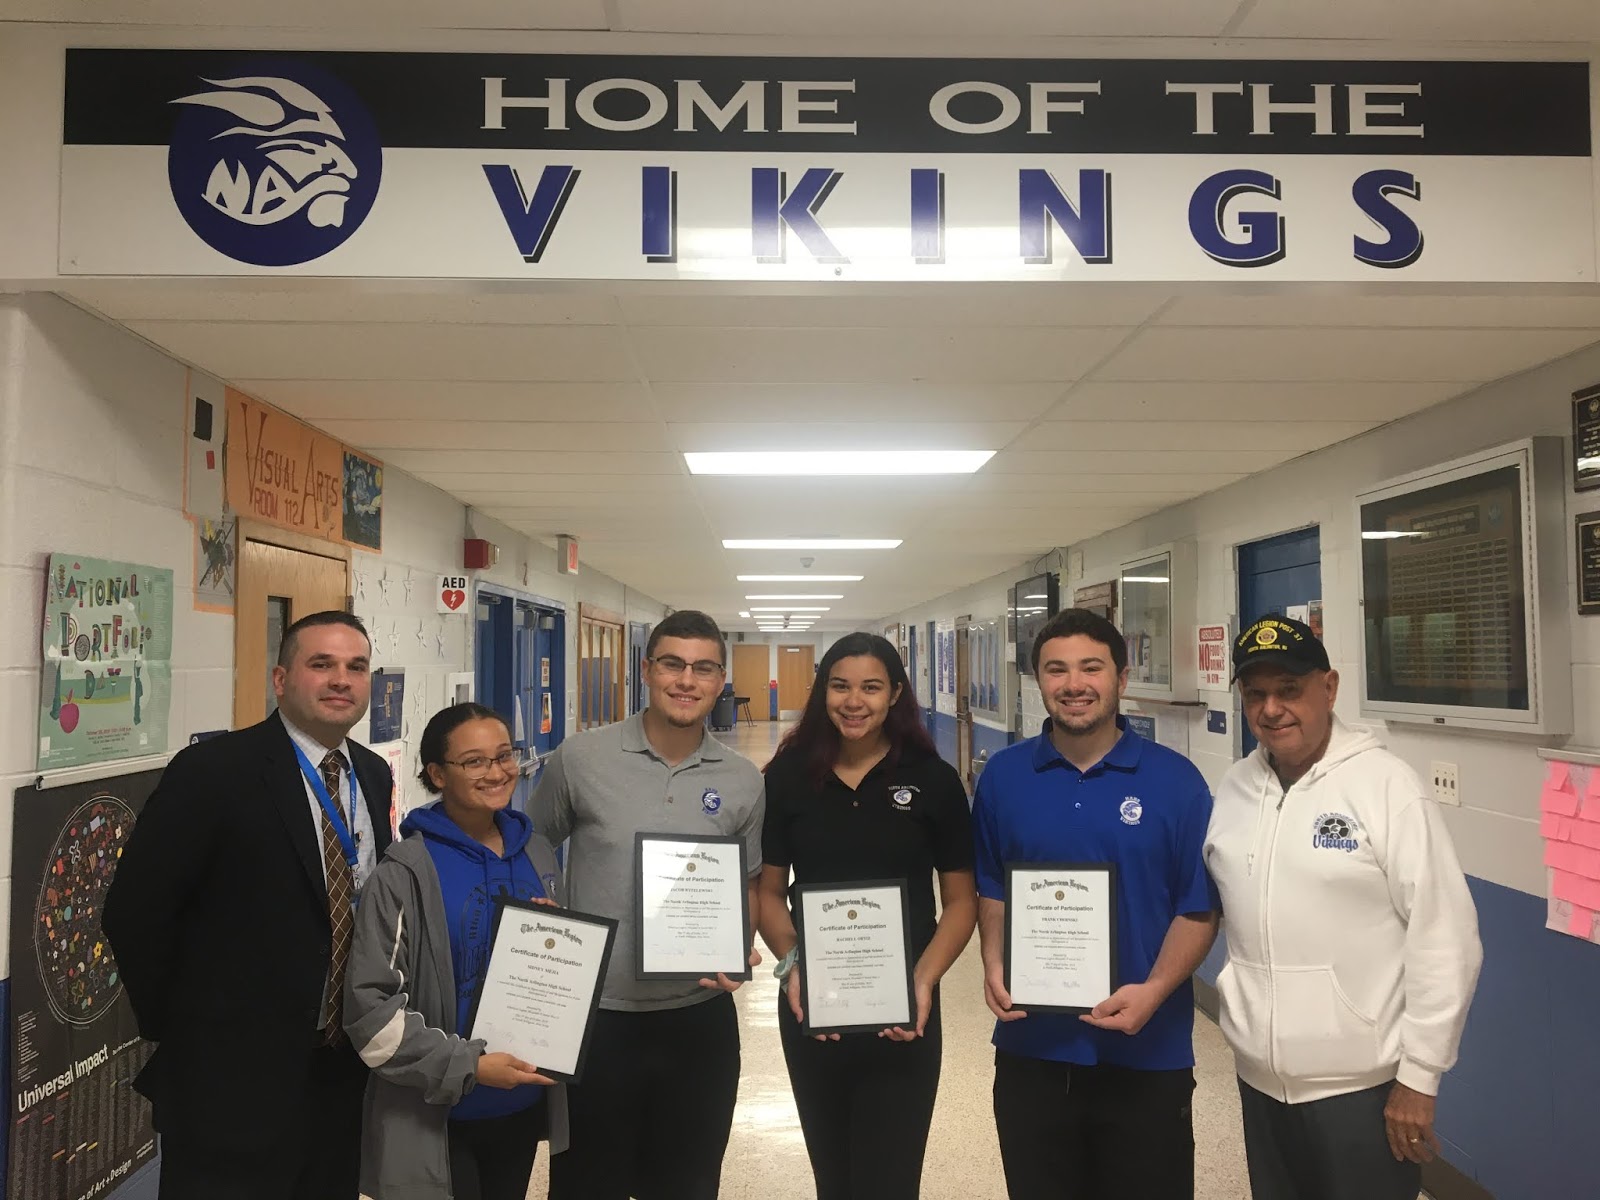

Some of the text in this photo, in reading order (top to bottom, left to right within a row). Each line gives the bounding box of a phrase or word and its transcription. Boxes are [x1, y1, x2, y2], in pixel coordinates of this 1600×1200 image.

[480, 77, 1424, 138] HOME OF THE
[481, 164, 1424, 268] VIKINGS
[442, 577, 466, 589] AED
[1259, 620, 1279, 629] LEGION
[1278, 622, 1295, 634] POST
[1198, 643, 1210, 672] NO
[1313, 834, 1359, 853] Vikings
[692, 876, 725, 884] Participation
[1030, 882, 1042, 892] The
[1043, 879, 1069, 889] American
[822, 903, 834, 913] The
[834, 898, 861, 908] American
[520, 923, 534, 934] The
[534, 922, 563, 937] American
[510, 947, 539, 959] Certificate
[547, 955, 583, 968] Participation
[18, 1044, 109, 1113] Universal Impact
[86, 1184, 95, 1200] of
[95, 1177, 105, 1194] Art
[110, 1159, 132, 1181] Design
